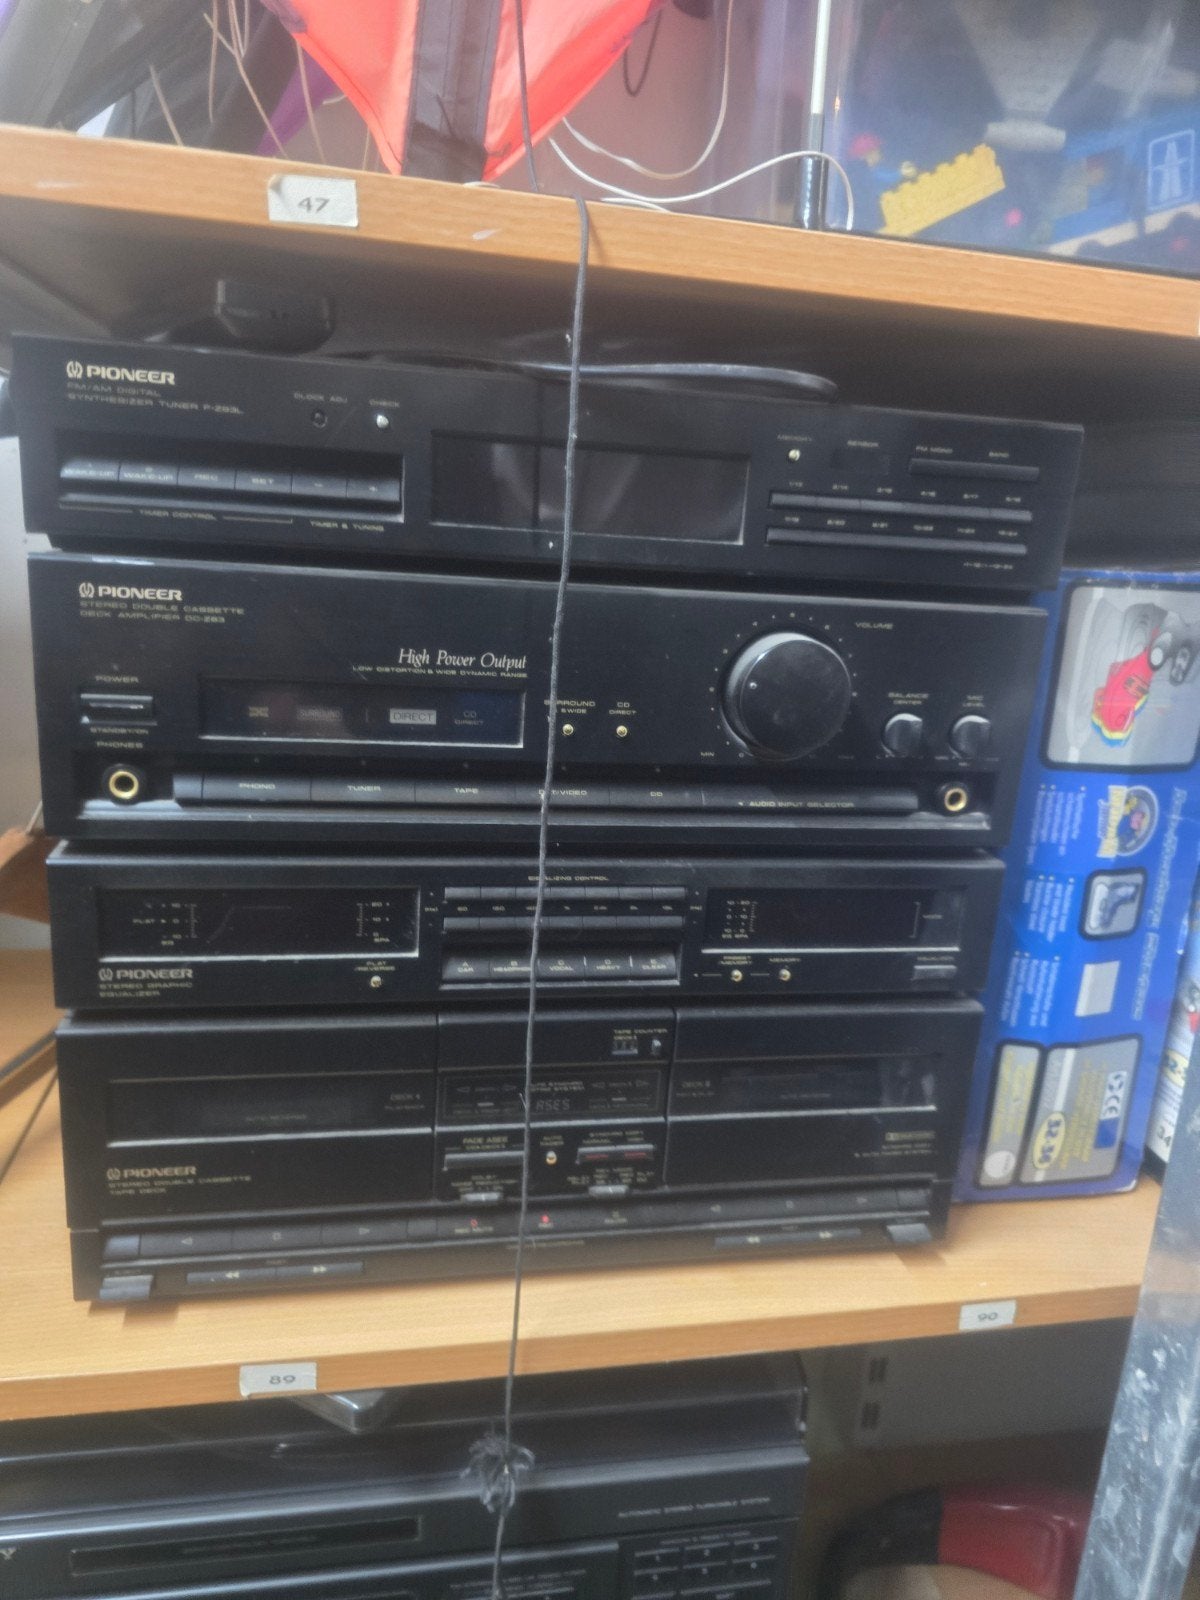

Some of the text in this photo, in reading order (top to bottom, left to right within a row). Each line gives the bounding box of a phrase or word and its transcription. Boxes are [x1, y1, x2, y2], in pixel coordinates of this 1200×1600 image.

[298, 196, 330, 213] 47
[86, 364, 176, 386] PIONEER
[158, 400, 199, 411] TUNER
[98, 585, 183, 601] PIONEER
[80, 600, 128, 609] STEREO
[183, 605, 245, 615] CASSETTE
[117, 611, 181, 621] AMPLIFIER
[855, 621, 894, 630] VOLUME
[398, 648, 527, 671] High Power Output
[376, 666, 426, 674] DISTORTION
[95, 675, 139, 683] POWER
[393, 711, 434, 724] DIRECT
[96, 740, 144, 749] PHONES
[347, 784, 382, 793] TUNER
[454, 787, 479, 795] TAPE
[116, 968, 194, 980] PIONEER
[123, 1166, 197, 1178] PIONEER
[977, 1312, 998, 1321] 90
[269, 1375, 296, 1385] 89
